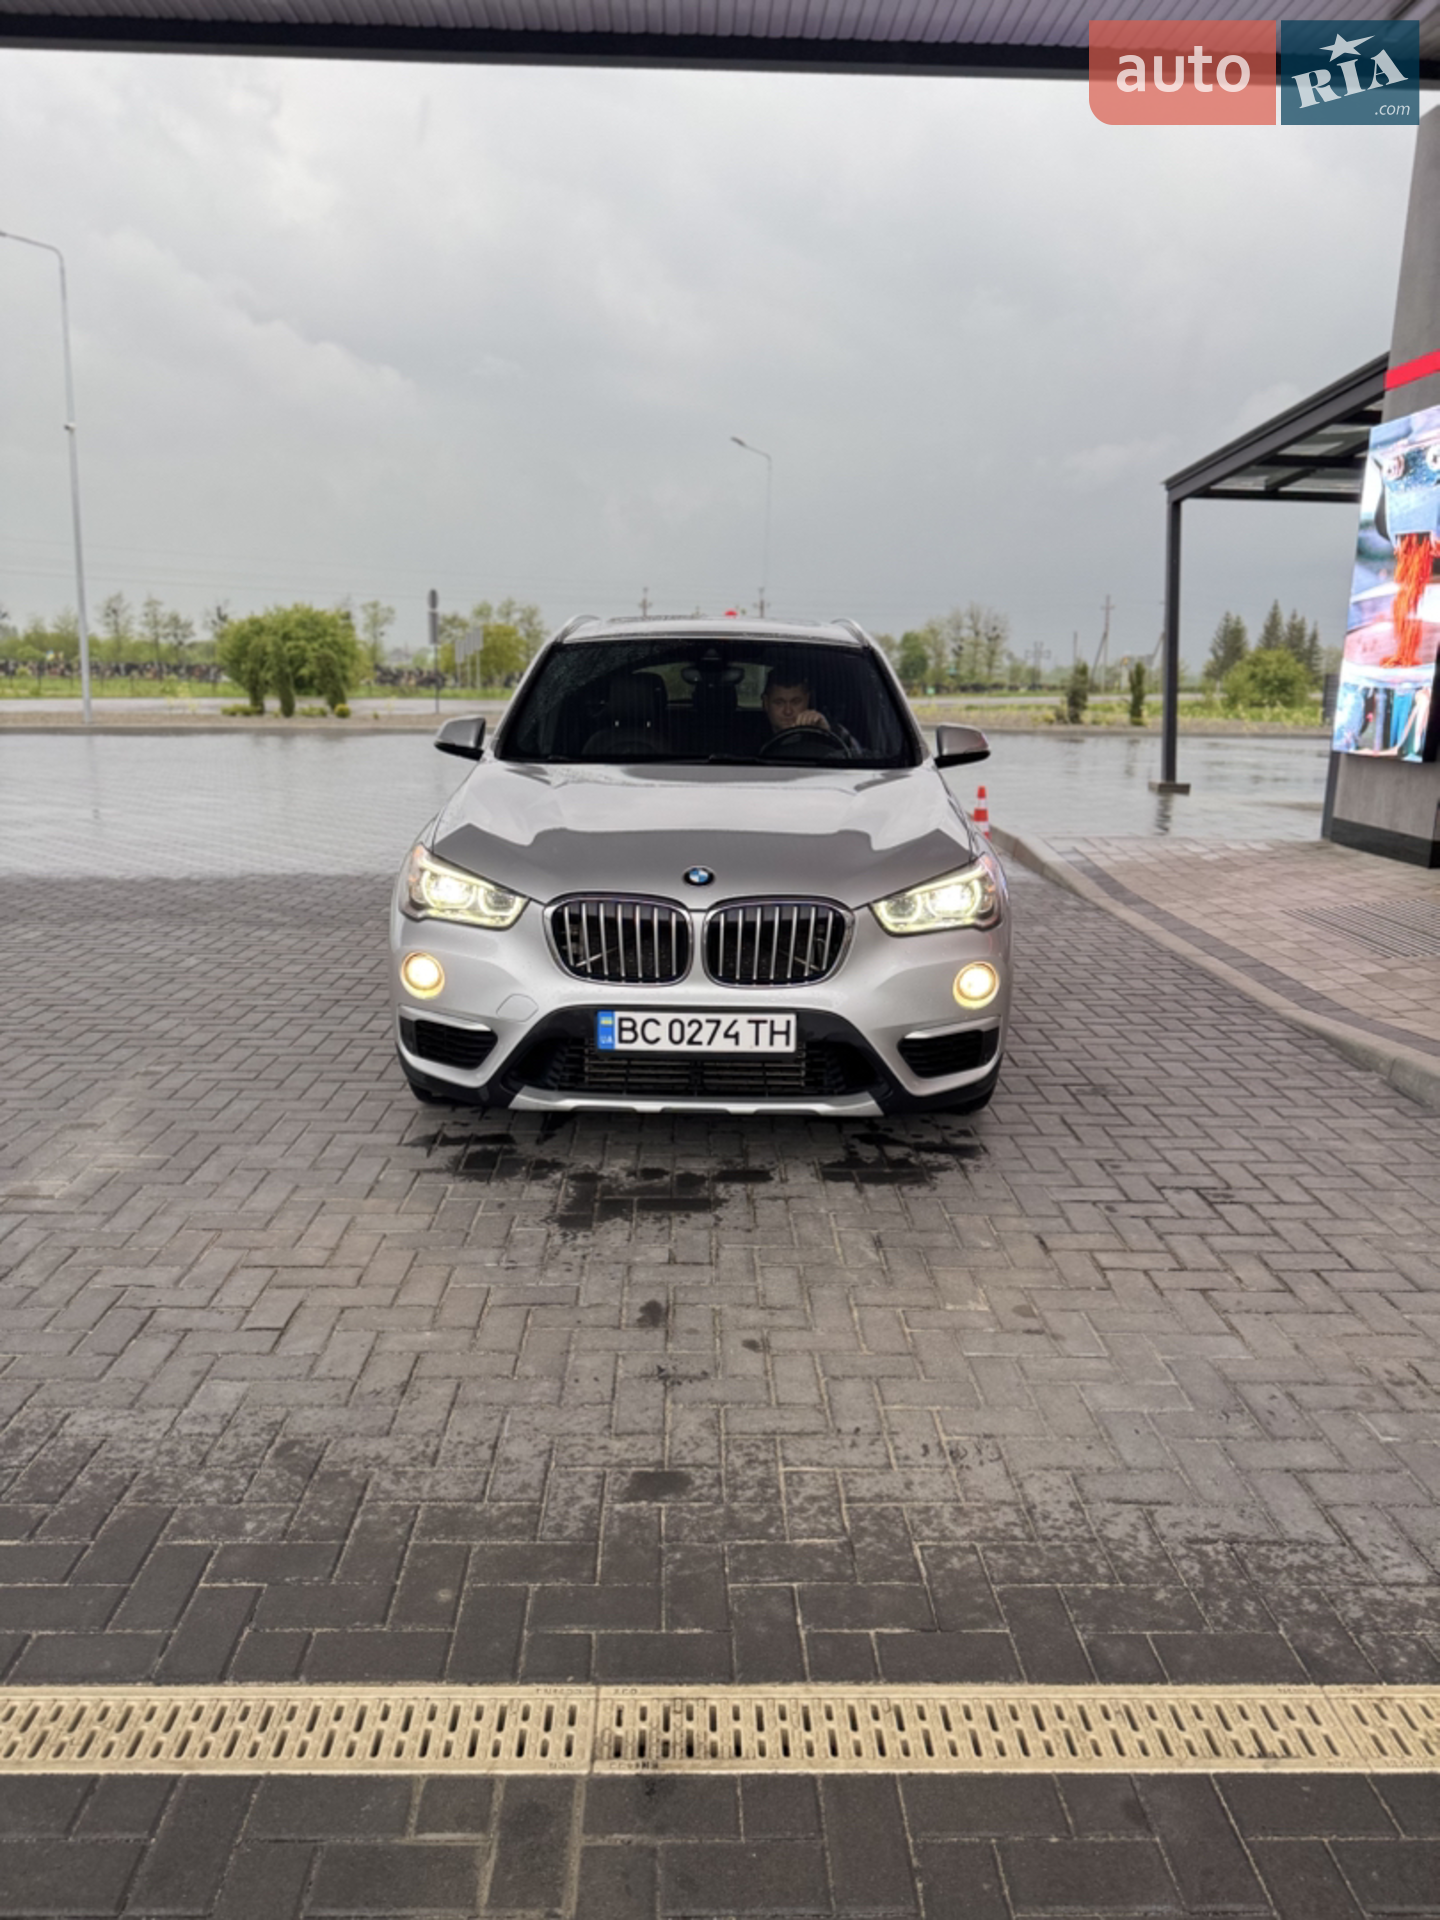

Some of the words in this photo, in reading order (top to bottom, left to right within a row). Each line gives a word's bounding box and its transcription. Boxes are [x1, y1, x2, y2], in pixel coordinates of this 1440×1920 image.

[617, 1017, 662, 1045] BC
[668, 1018, 741, 1046] 0274
[747, 1019, 791, 1047] TH
